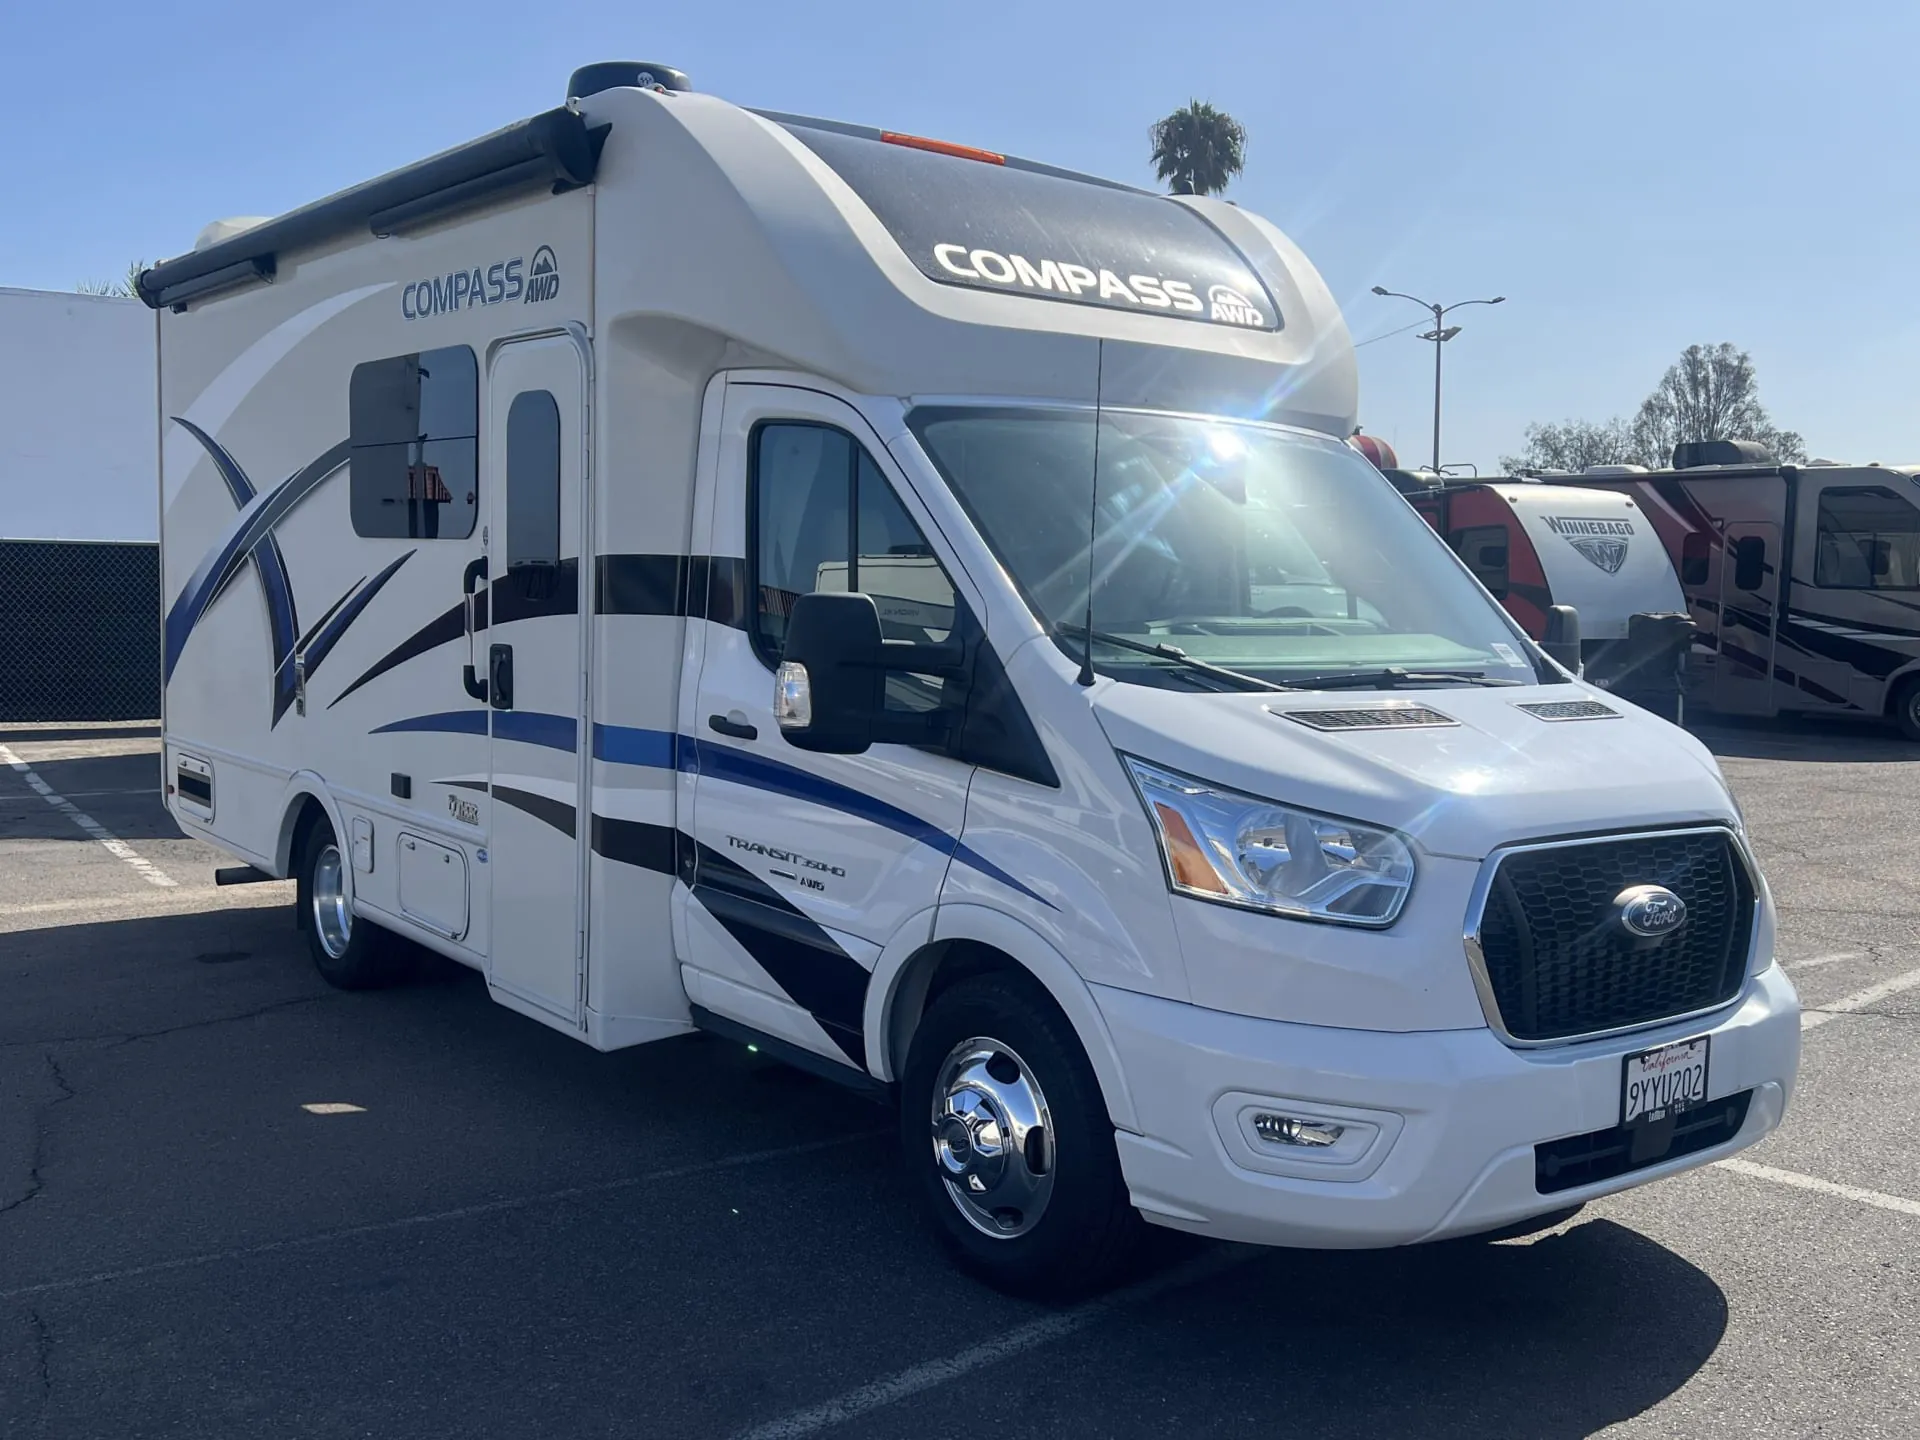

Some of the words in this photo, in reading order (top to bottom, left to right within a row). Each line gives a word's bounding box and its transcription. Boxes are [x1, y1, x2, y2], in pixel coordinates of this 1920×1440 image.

[402, 256, 524, 320] COMPASS
[524, 274, 560, 304] AWD
[933, 243, 1204, 312] COMPASS
[1210, 303, 1264, 326] AWD
[1540, 516, 1635, 536] WINNEBAGO
[726, 835, 801, 864] TRANSIT
[800, 876, 825, 891] AWD
[1643, 900, 1677, 927] Ford
[1642, 1049, 1693, 1073] California
[1629, 1064, 1703, 1117] 9YYU202
